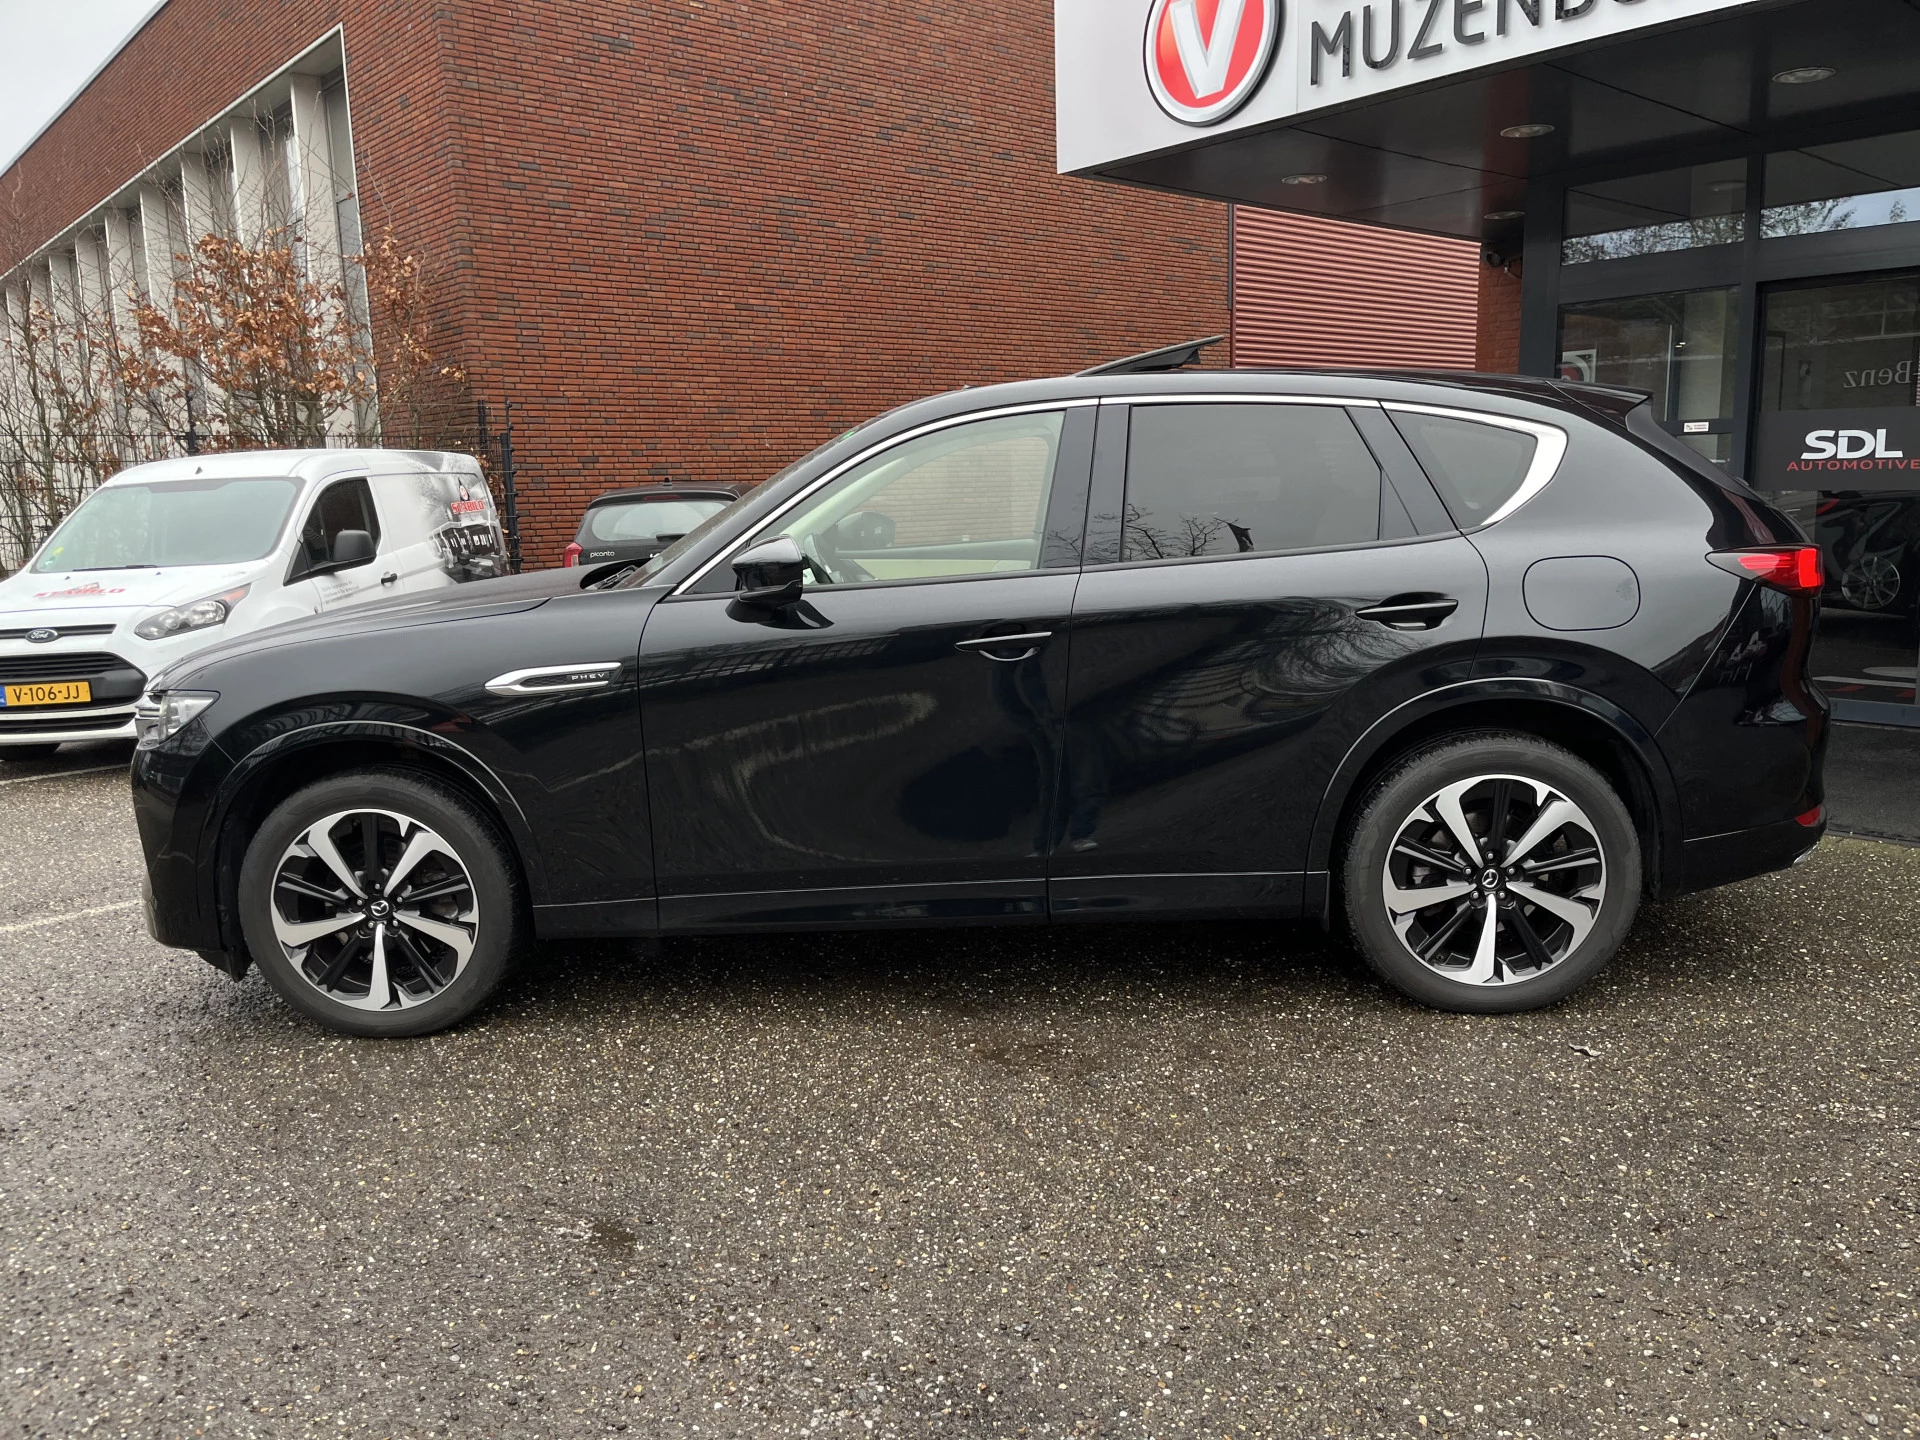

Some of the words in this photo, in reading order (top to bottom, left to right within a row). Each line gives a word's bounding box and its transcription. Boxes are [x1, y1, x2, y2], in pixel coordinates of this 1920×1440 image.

[1800, 428, 1904, 459] SDL
[1786, 458, 1920, 472] AUTOMOTIVE
[451, 500, 485, 515] STABILO
[589, 550, 615, 559] picanto
[31, 630, 49, 639] Ford
[571, 673, 606, 681] PHEV
[13, 685, 80, 702] V-106-JJ
